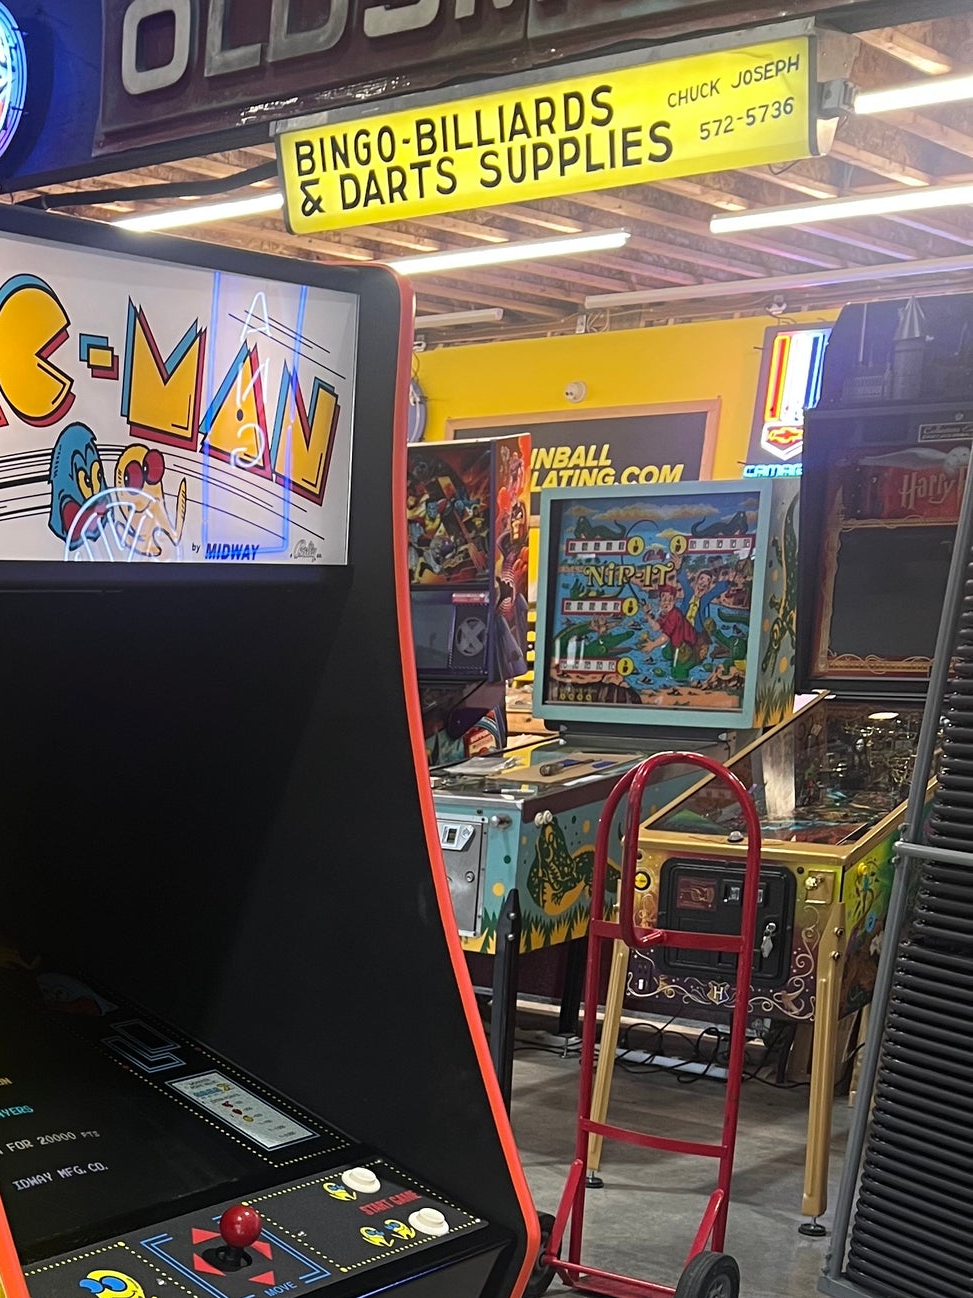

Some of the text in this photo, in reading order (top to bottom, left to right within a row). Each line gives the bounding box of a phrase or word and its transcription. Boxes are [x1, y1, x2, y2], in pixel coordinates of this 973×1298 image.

[667, 54, 800, 108] CHUCK JOSEPH
[294, 84, 614, 177] BINGO-BILLIARDS
[699, 96, 795, 141] 572-5736
[300, 120, 674, 218] & DARTS SUPPLIES
[191, 543, 260, 561] by MIDWAY
[6, 1138, 34, 1152] FOR
[36, 1131, 77, 1146] 20000
[12, 1172, 53, 1191] IDWAY
[358, 1189, 423, 1216] START GAME
[264, 1280, 298, 1298] MOVE
